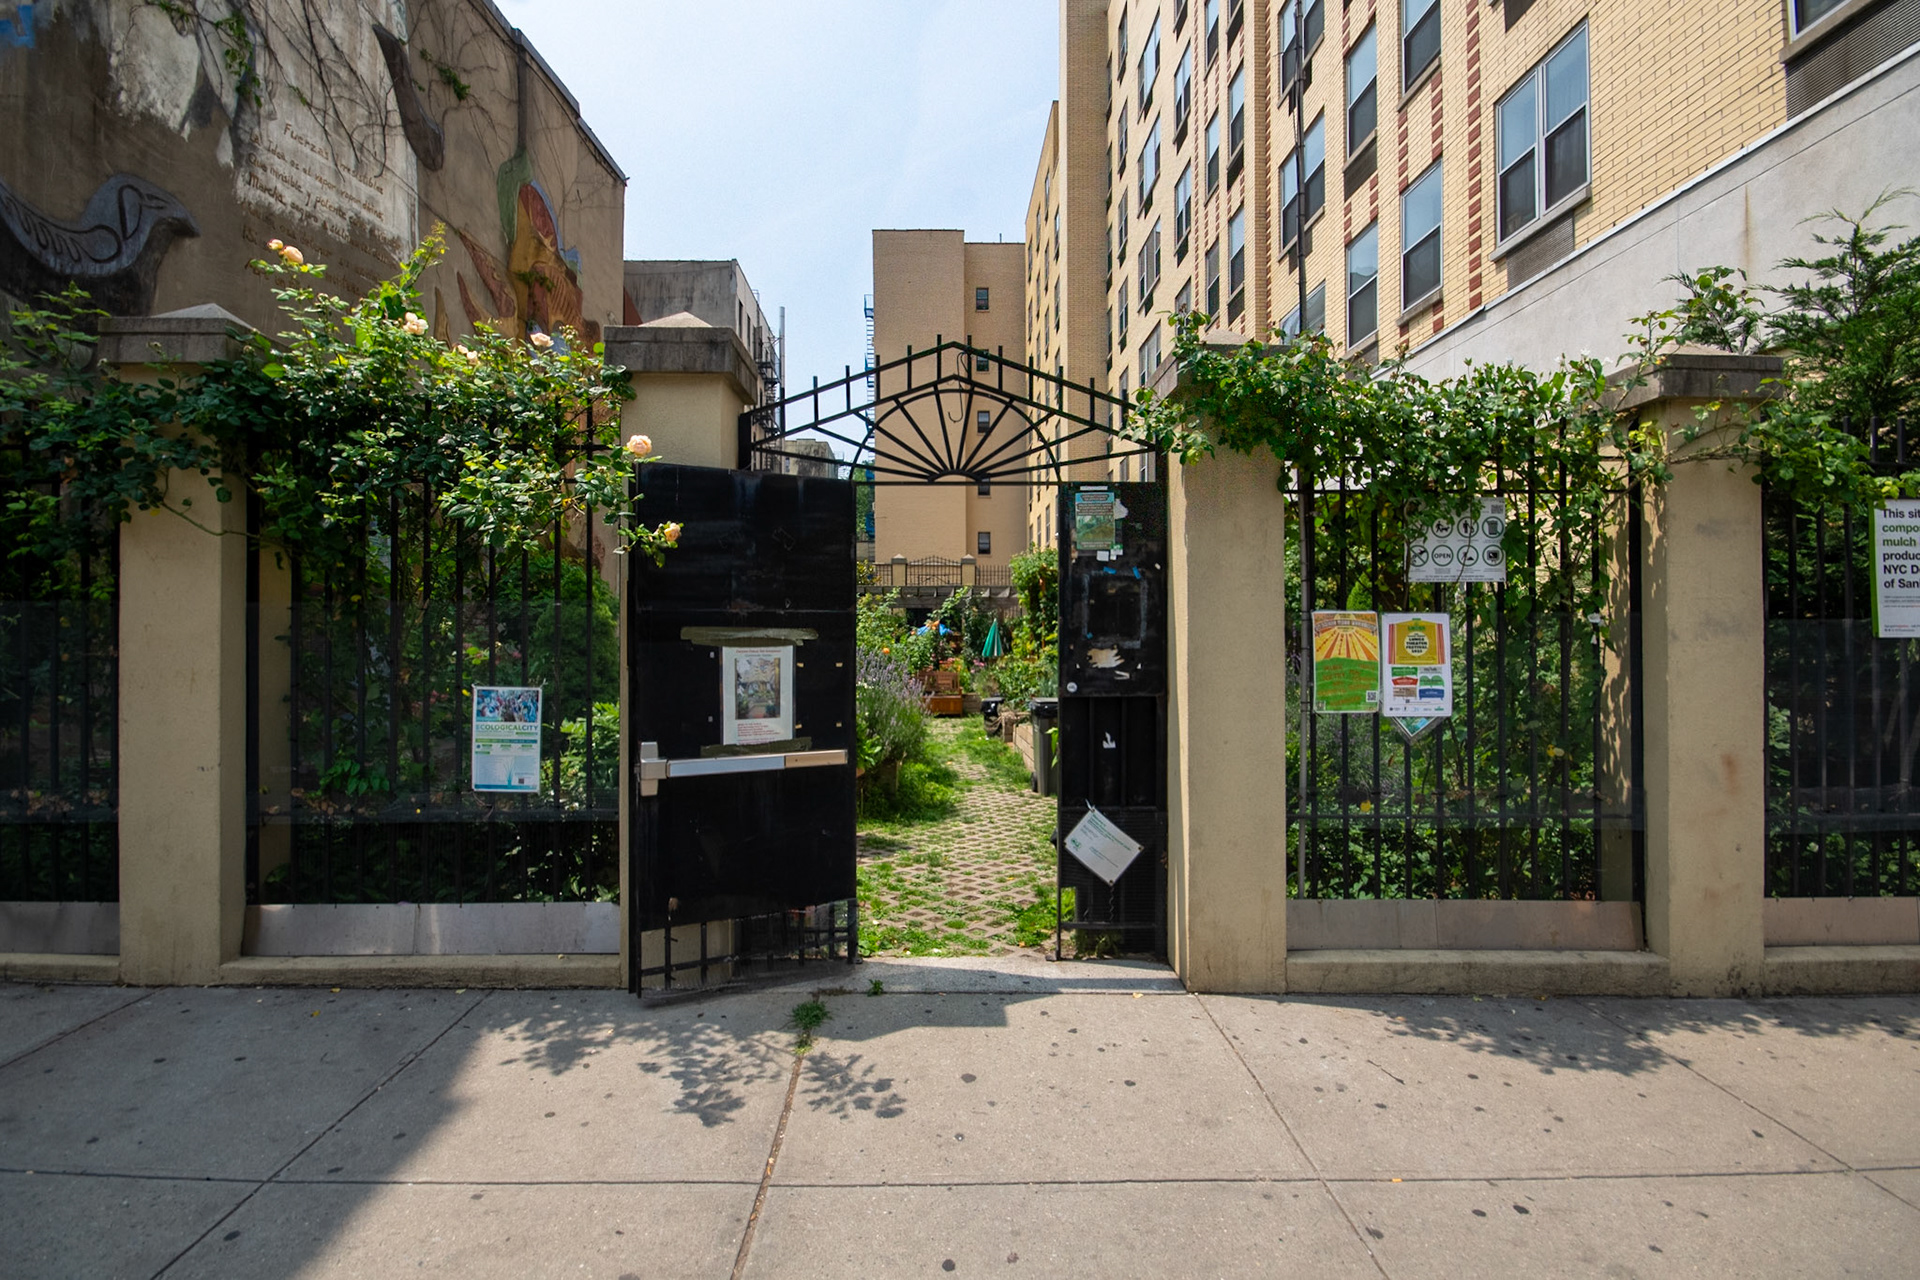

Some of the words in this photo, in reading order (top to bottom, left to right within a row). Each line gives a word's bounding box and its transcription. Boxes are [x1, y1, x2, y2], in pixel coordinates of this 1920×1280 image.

[283, 122, 330, 160] Fuerzas
[249, 131, 261, 147] La
[267, 139, 287, 162] Idea
[289, 159, 300, 170] es
[303, 166, 312, 177] el
[248, 152, 268, 173] Que
[305, 191, 312, 207] y
[314, 196, 347, 221] potente
[248, 171, 287, 207] Marcha
[1883, 509, 1905, 519] This
[1882, 525, 1920, 534] compo
[1882, 537, 1916, 546] mulch
[1884, 564, 1907, 574] NYC
[1884, 578, 1895, 589] of
[1898, 578, 1920, 589] San
